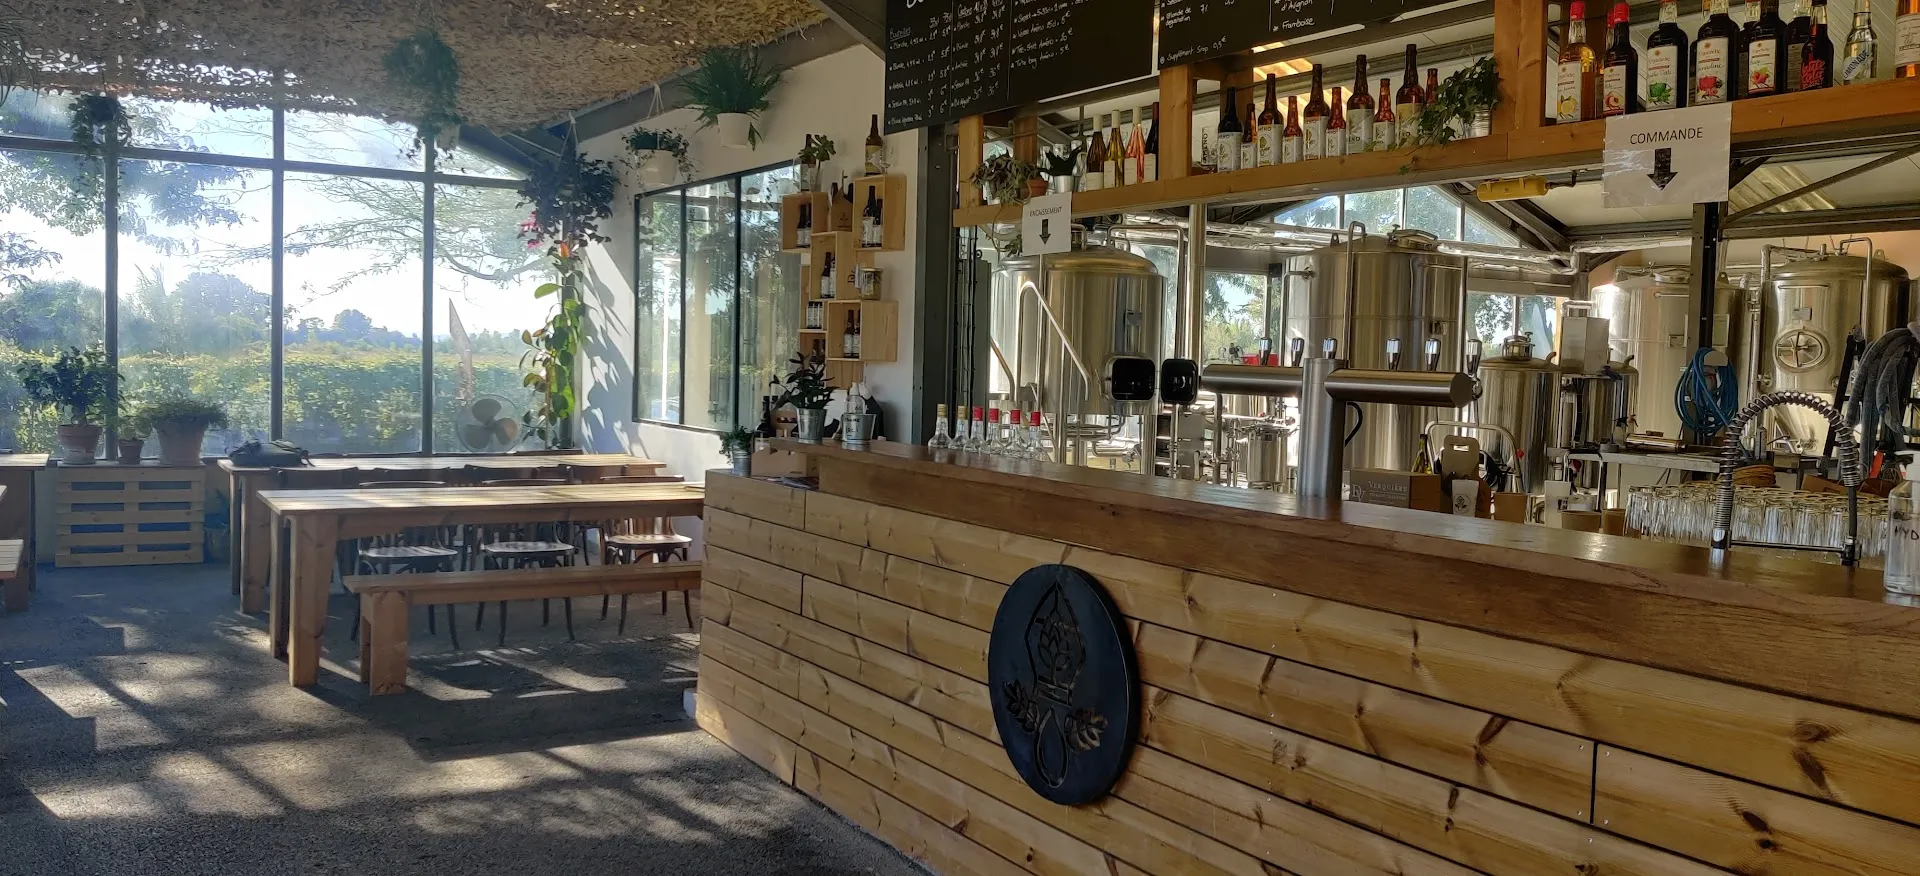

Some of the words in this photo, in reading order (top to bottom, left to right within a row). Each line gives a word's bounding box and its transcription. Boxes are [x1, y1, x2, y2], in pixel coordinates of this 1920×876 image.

[1282, 17, 1316, 30] Framboise
[1630, 127, 1704, 145] COMMANDE
[1029, 206, 1063, 217] ENCAISSEMENT
